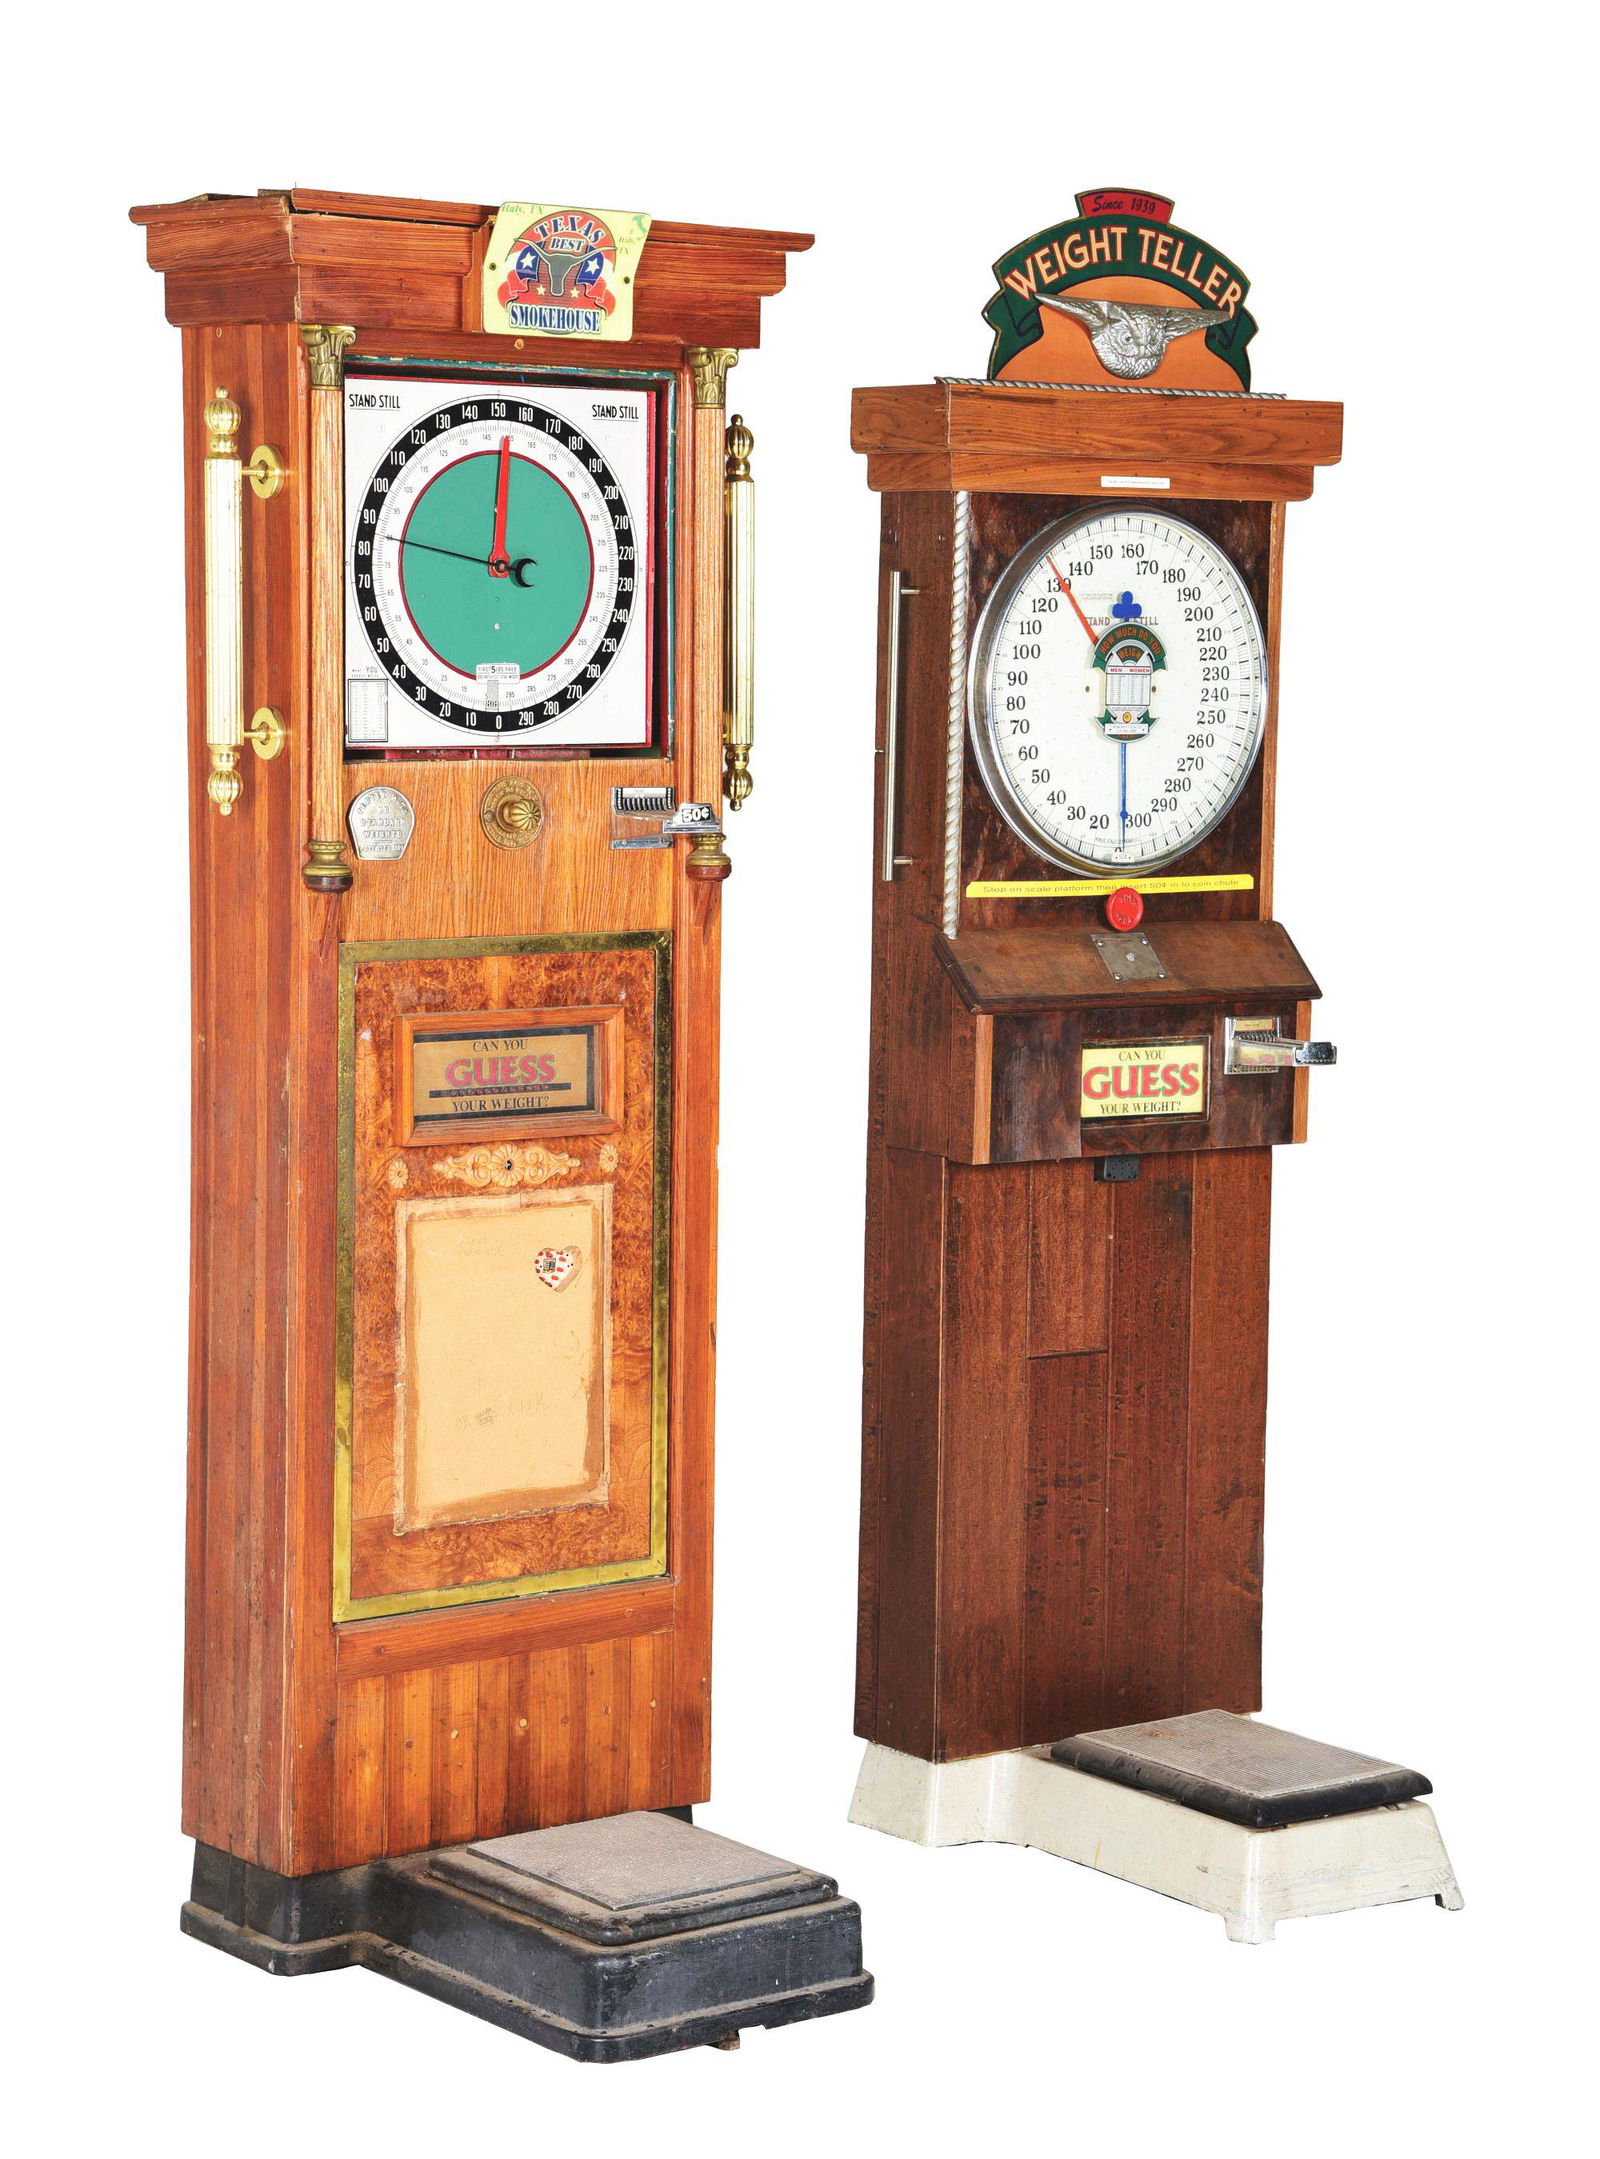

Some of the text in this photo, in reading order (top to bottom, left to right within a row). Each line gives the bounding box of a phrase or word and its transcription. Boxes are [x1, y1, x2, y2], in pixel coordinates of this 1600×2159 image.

[1092, 195, 1156, 214] Since 1939
[535, 216, 605, 245] TEXAS
[550, 237, 585, 251] BEST
[1003, 226, 1242, 320] WEIGHT TELLER
[509, 304, 601, 332] SMOKEHOUSE
[349, 394, 400, 408] STAND STILL
[462, 405, 478, 419] 140
[492, 402, 506, 417] 150
[519, 407, 533, 422] 160
[592, 404, 639, 419] STAND STILL
[436, 414, 450, 429] 130
[546, 419, 561, 433] 170
[411, 430, 426, 444] 120
[567, 436, 583, 451] 180
[391, 451, 405, 465] 110
[589, 457, 603, 472] 190
[374, 478, 389, 493] 100
[603, 485, 619, 501] 200
[364, 509, 376, 524] 90
[614, 515, 629, 529] 210
[358, 541, 370, 555] 80
[618, 546, 634, 561] 220
[1091, 545, 1113, 559] 150
[1121, 544, 1145, 558] 160
[1069, 561, 1093, 576] 140
[1137, 560, 1158, 575] 170
[359, 574, 370, 588] 70
[1163, 568, 1185, 583] 180
[618, 577, 633, 591] 230
[1178, 587, 1201, 602] 190
[1032, 598, 1058, 612] 120
[365, 606, 376, 621] 60
[612, 608, 629, 623] 240
[1085, 616, 1110, 626] TAND
[1185, 607, 1213, 621] 200
[1020, 620, 1041, 635] 110
[1197, 627, 1222, 641] 210
[377, 638, 389, 653] 50
[601, 637, 617, 653] 250
[1099, 627, 1161, 656] HOW MUCH DO YOU
[1013, 644, 1040, 659] 100
[1118, 646, 1141, 659] WEIGH
[1200, 646, 1227, 660] 220
[392, 665, 406, 678] 40
[491, 665, 496, 673] 5
[586, 663, 601, 679] 260
[1203, 666, 1229, 680] 230
[1008, 671, 1028, 686] 90
[415, 686, 426, 701] 30
[566, 684, 583, 700] 270
[1201, 687, 1229, 702] 240
[439, 702, 450, 717] 20
[544, 701, 560, 716] 280
[1007, 696, 1025, 710] 80
[466, 712, 476, 726] 10
[496, 715, 502, 729] 0
[519, 711, 534, 725] 290
[1197, 709, 1226, 725] 250
[1010, 719, 1030, 734] 70
[1187, 733, 1214, 749] 260
[1019, 746, 1038, 761] 60
[1177, 756, 1204, 772] 270
[1032, 770, 1050, 783] 50
[1164, 778, 1191, 793] 280
[1047, 790, 1066, 805] 40
[1151, 797, 1177, 812] 290
[682, 807, 710, 823] 50¢
[1067, 806, 1085, 820] 30
[1126, 813, 1152, 828] 300
[360, 818, 406, 827] STANDARD
[1090, 815, 1109, 829] 20
[363, 830, 403, 839] WEIGHTS
[1054, 885, 1093, 893] platform
[473, 1038, 529, 1052] CAN YOU
[1118, 1049, 1167, 1062] CAN YOU
[445, 1053, 557, 1088] GUESS
[1082, 1062, 1200, 1100] GUESS
[452, 1095, 550, 1112] YOUR WEIGHT?
[1100, 1101, 1181, 1114] YOUR WEIGHT?
